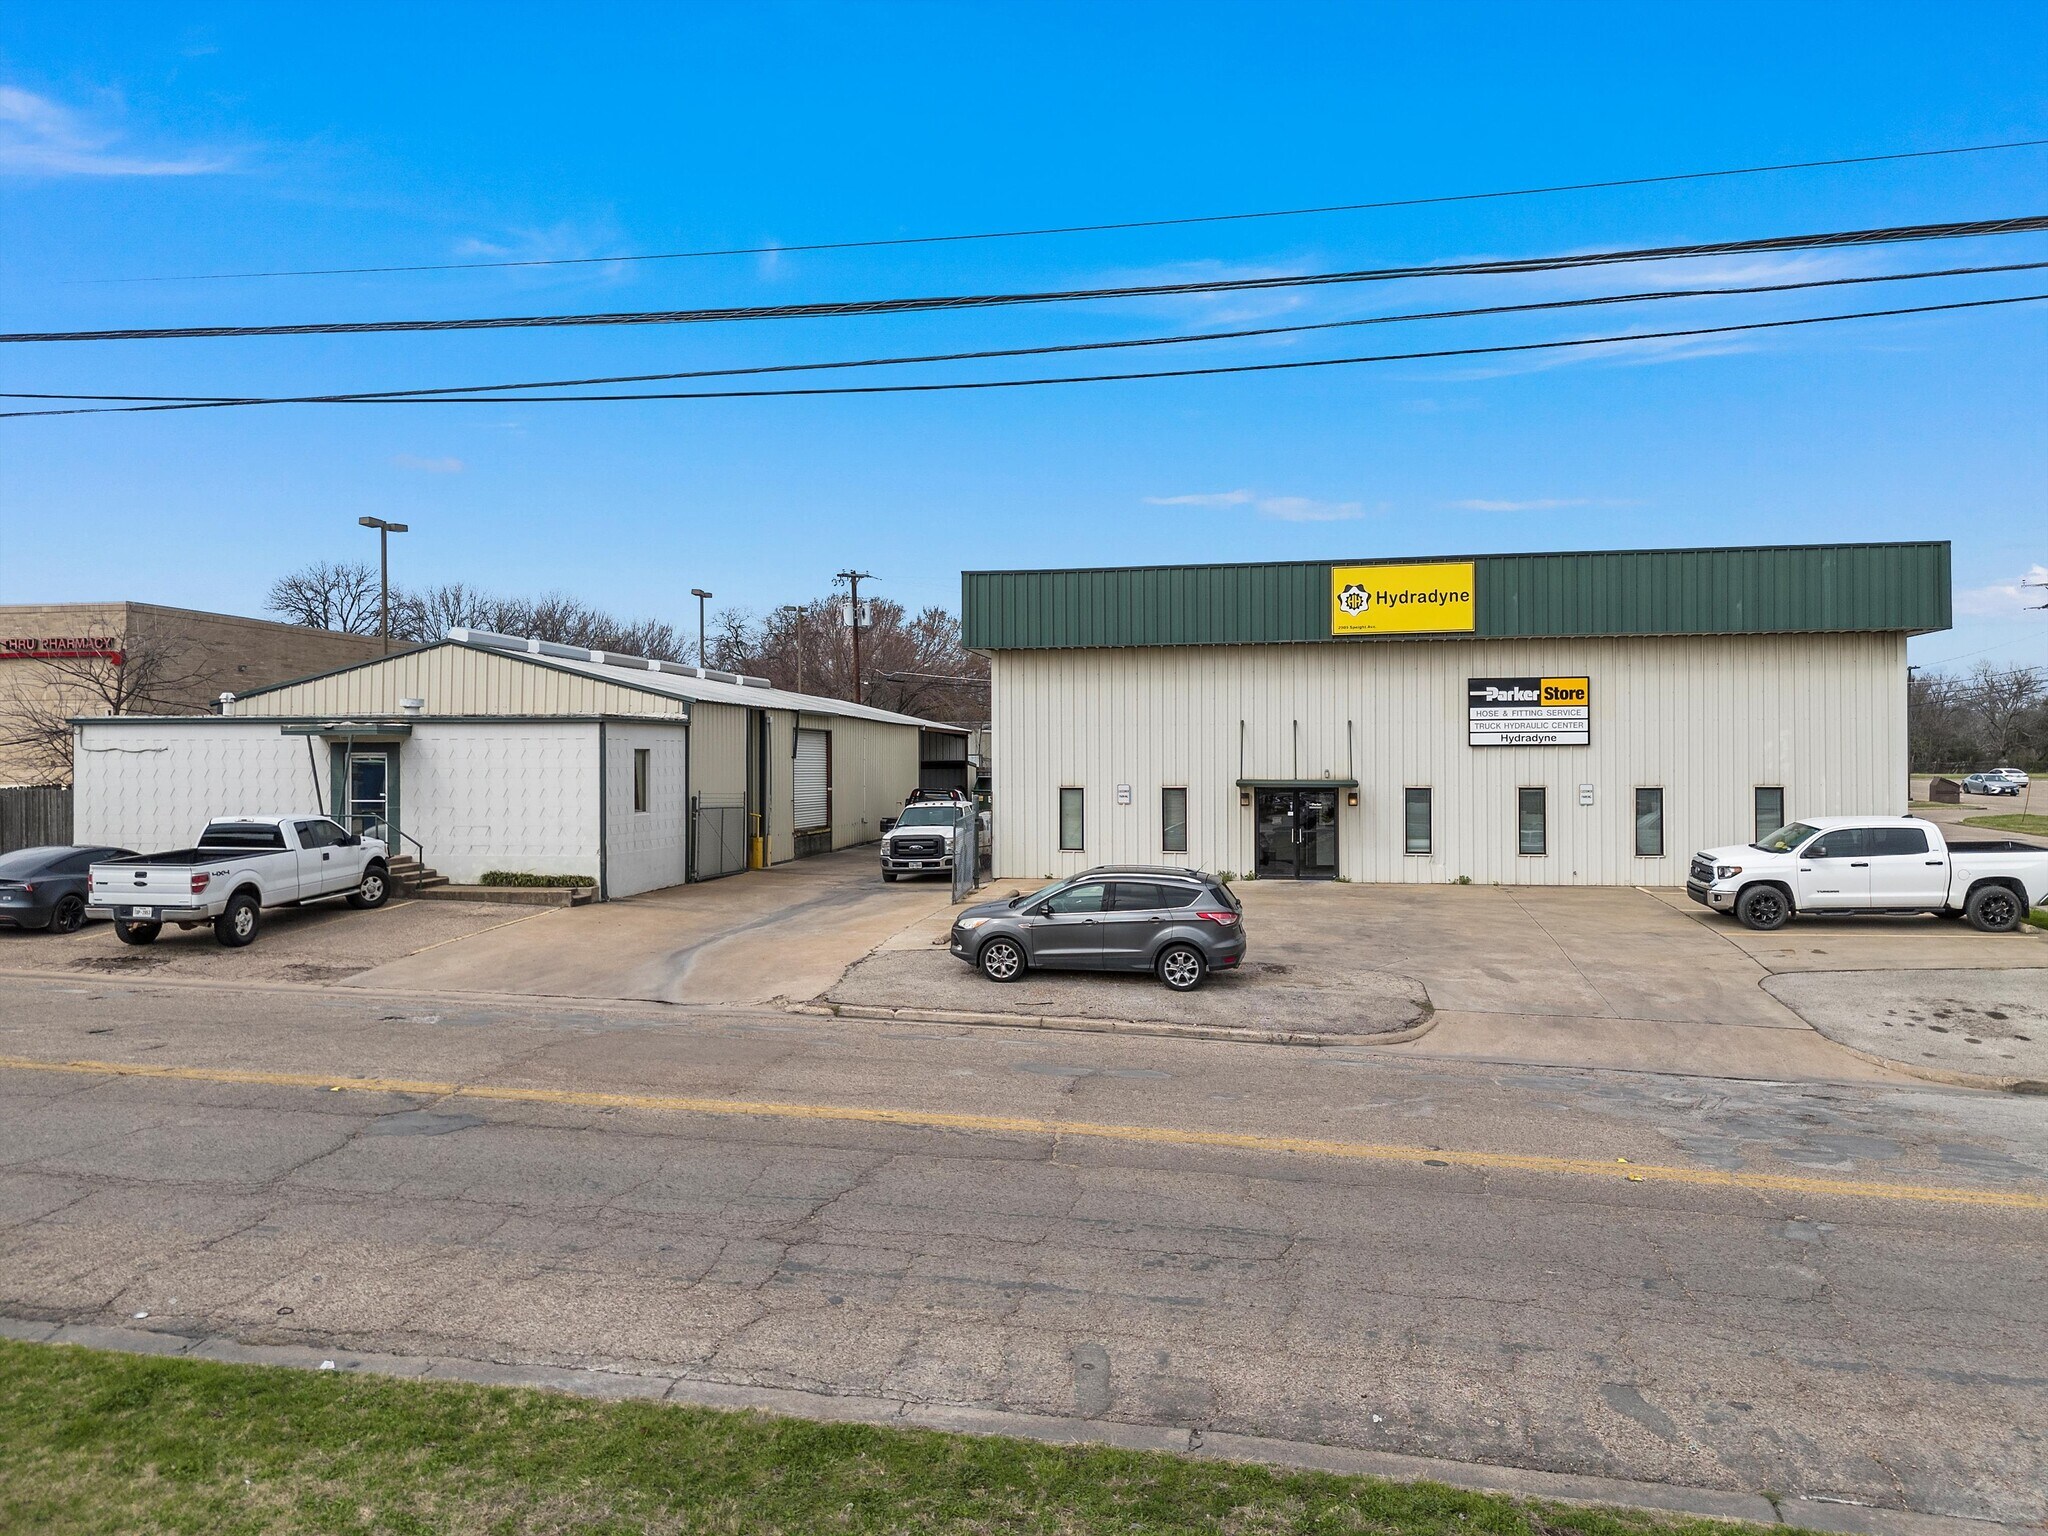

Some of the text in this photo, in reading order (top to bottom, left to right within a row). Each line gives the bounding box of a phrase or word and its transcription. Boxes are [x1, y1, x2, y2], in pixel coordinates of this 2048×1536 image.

[1376, 589, 1470, 608] Hydradyne
[42, 637, 111, 650] PHARMACY
[1486, 686, 1585, 701] Parker Store
[1511, 709, 1543, 717] FITTING
[1546, 708, 1582, 716] SERVICE
[1474, 722, 1501, 730] TRUCK
[1503, 721, 1549, 729] HYDRAULIC
[1501, 734, 1557, 743] Hydradyne
